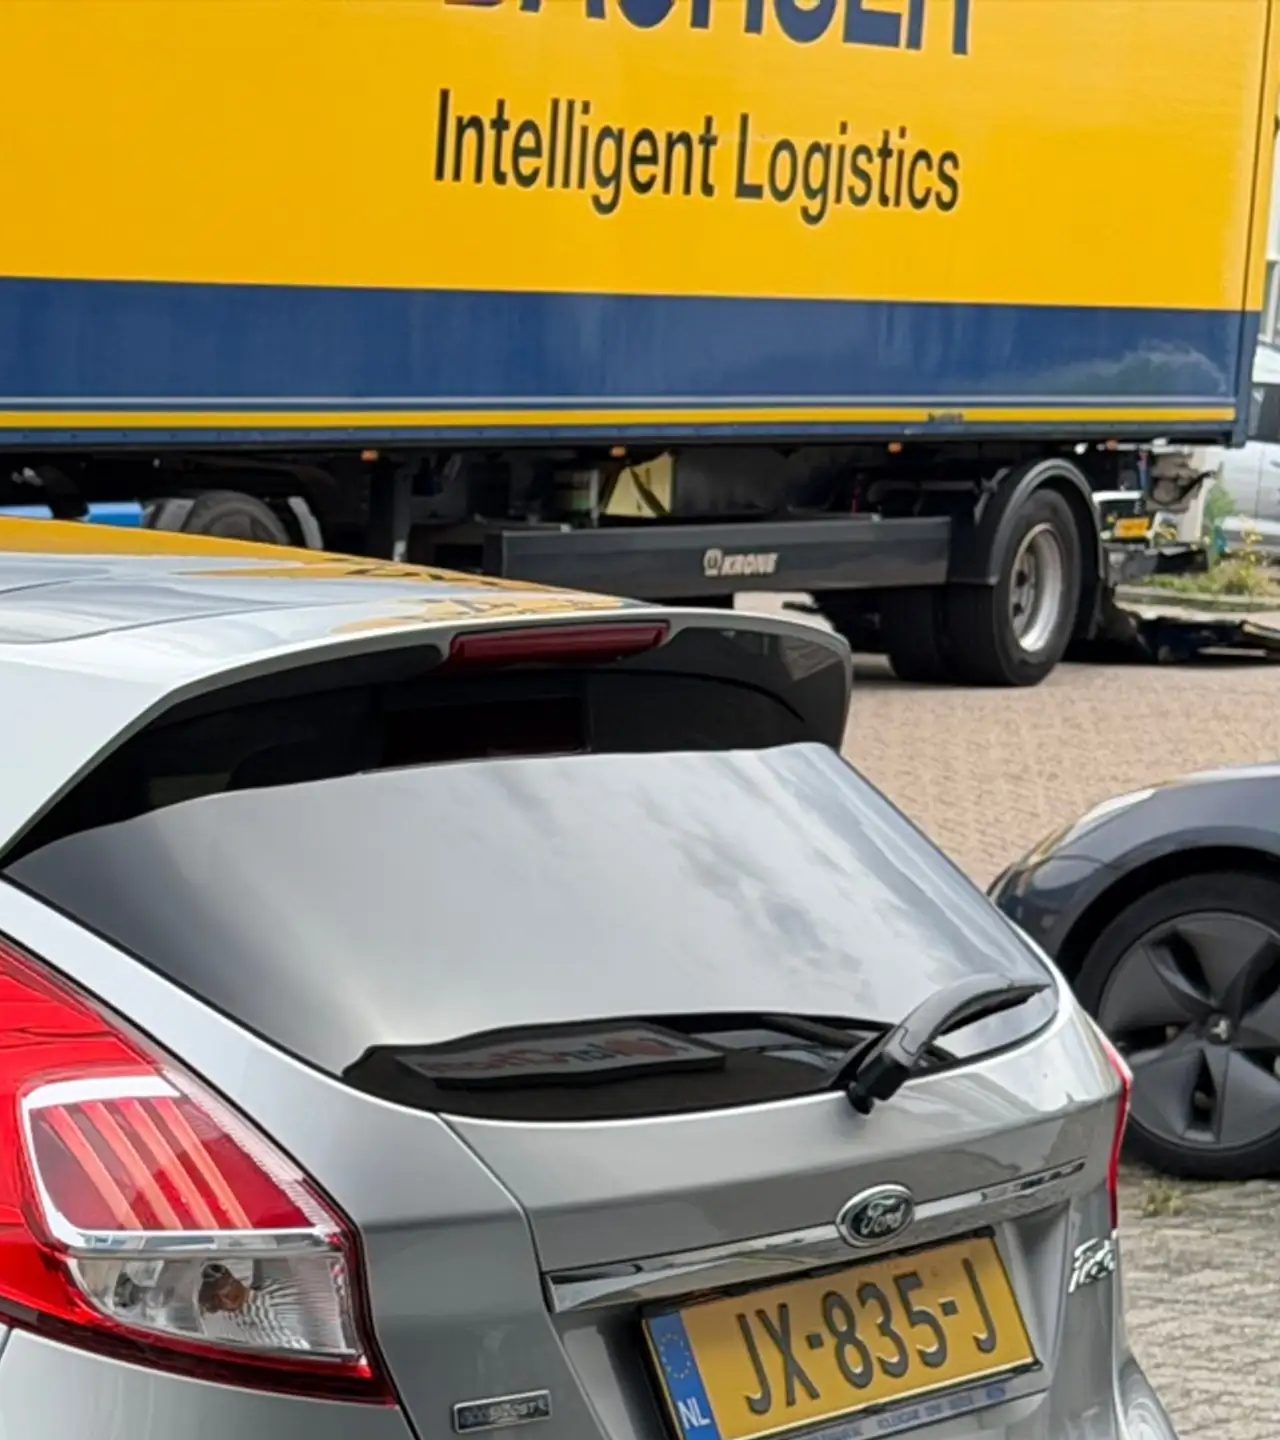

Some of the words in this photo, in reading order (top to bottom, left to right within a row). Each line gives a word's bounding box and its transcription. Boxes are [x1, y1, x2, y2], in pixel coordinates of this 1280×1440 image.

[434, 88, 718, 215] Intelligent
[734, 113, 960, 226] Logistics
[860, 1196, 906, 1236] Ford
[735, 1257, 997, 1415] JX-835-J
[678, 1396, 712, 1431] NL
